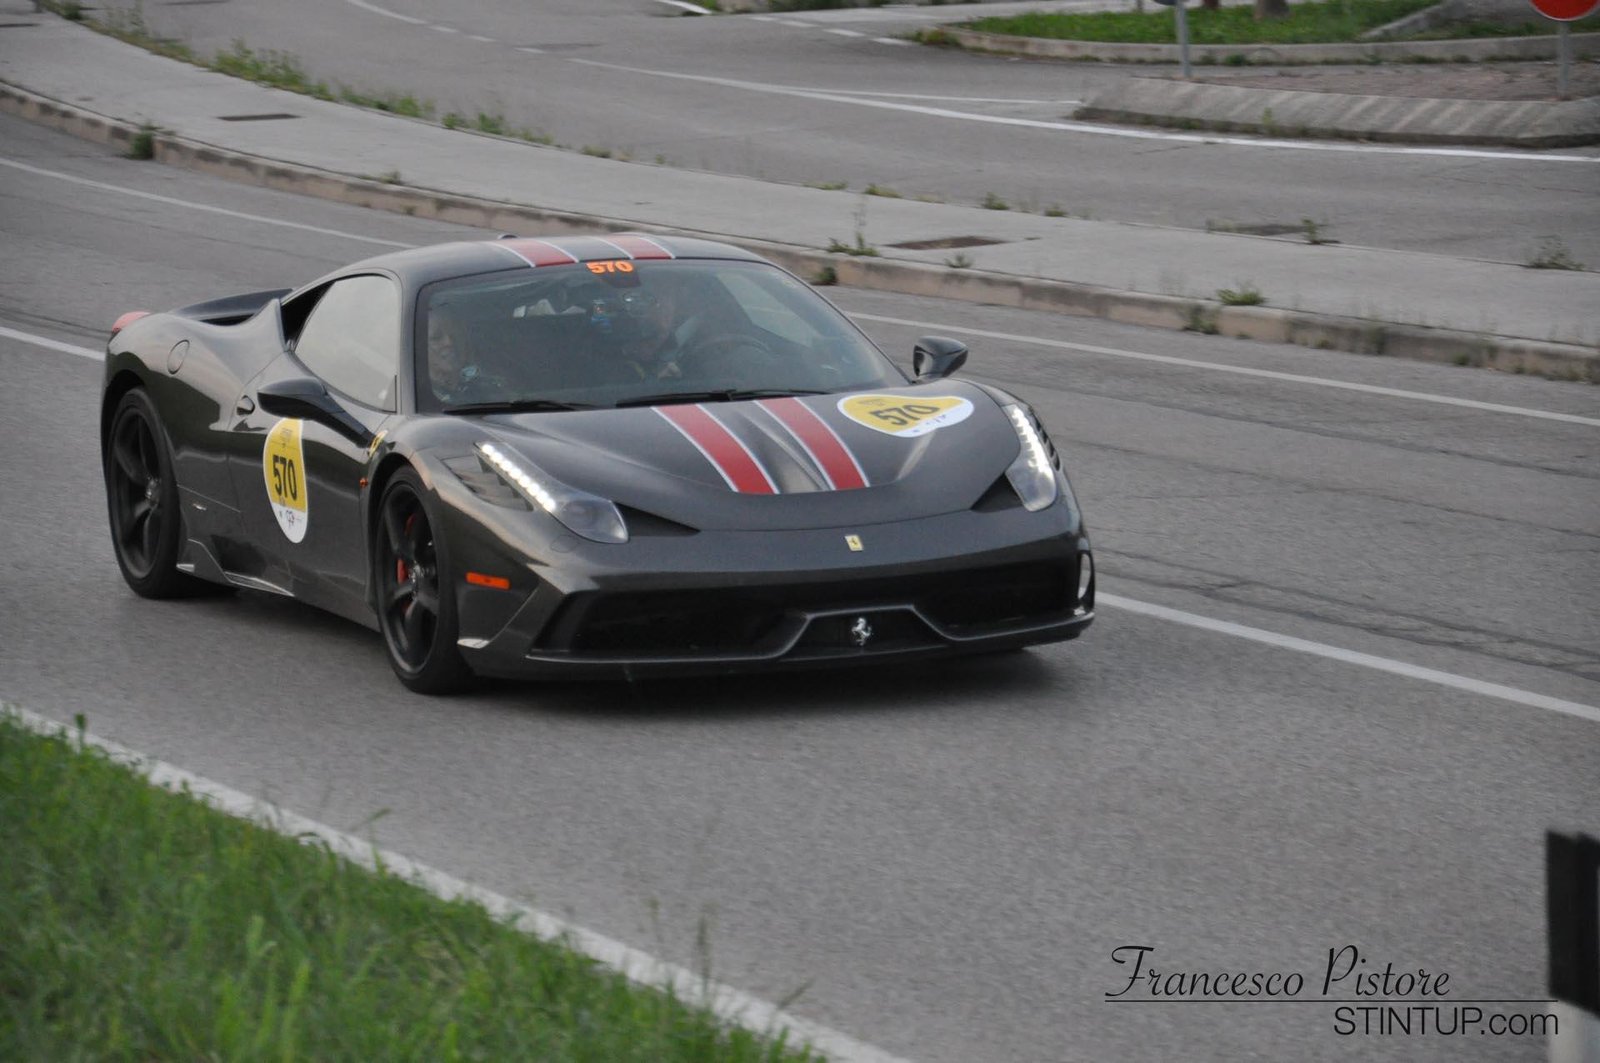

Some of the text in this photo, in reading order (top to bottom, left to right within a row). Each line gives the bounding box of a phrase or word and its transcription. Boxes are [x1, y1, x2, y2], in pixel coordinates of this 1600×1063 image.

[586, 260, 634, 274] 570
[869, 404, 940, 426] 570
[272, 454, 298, 501] 570
